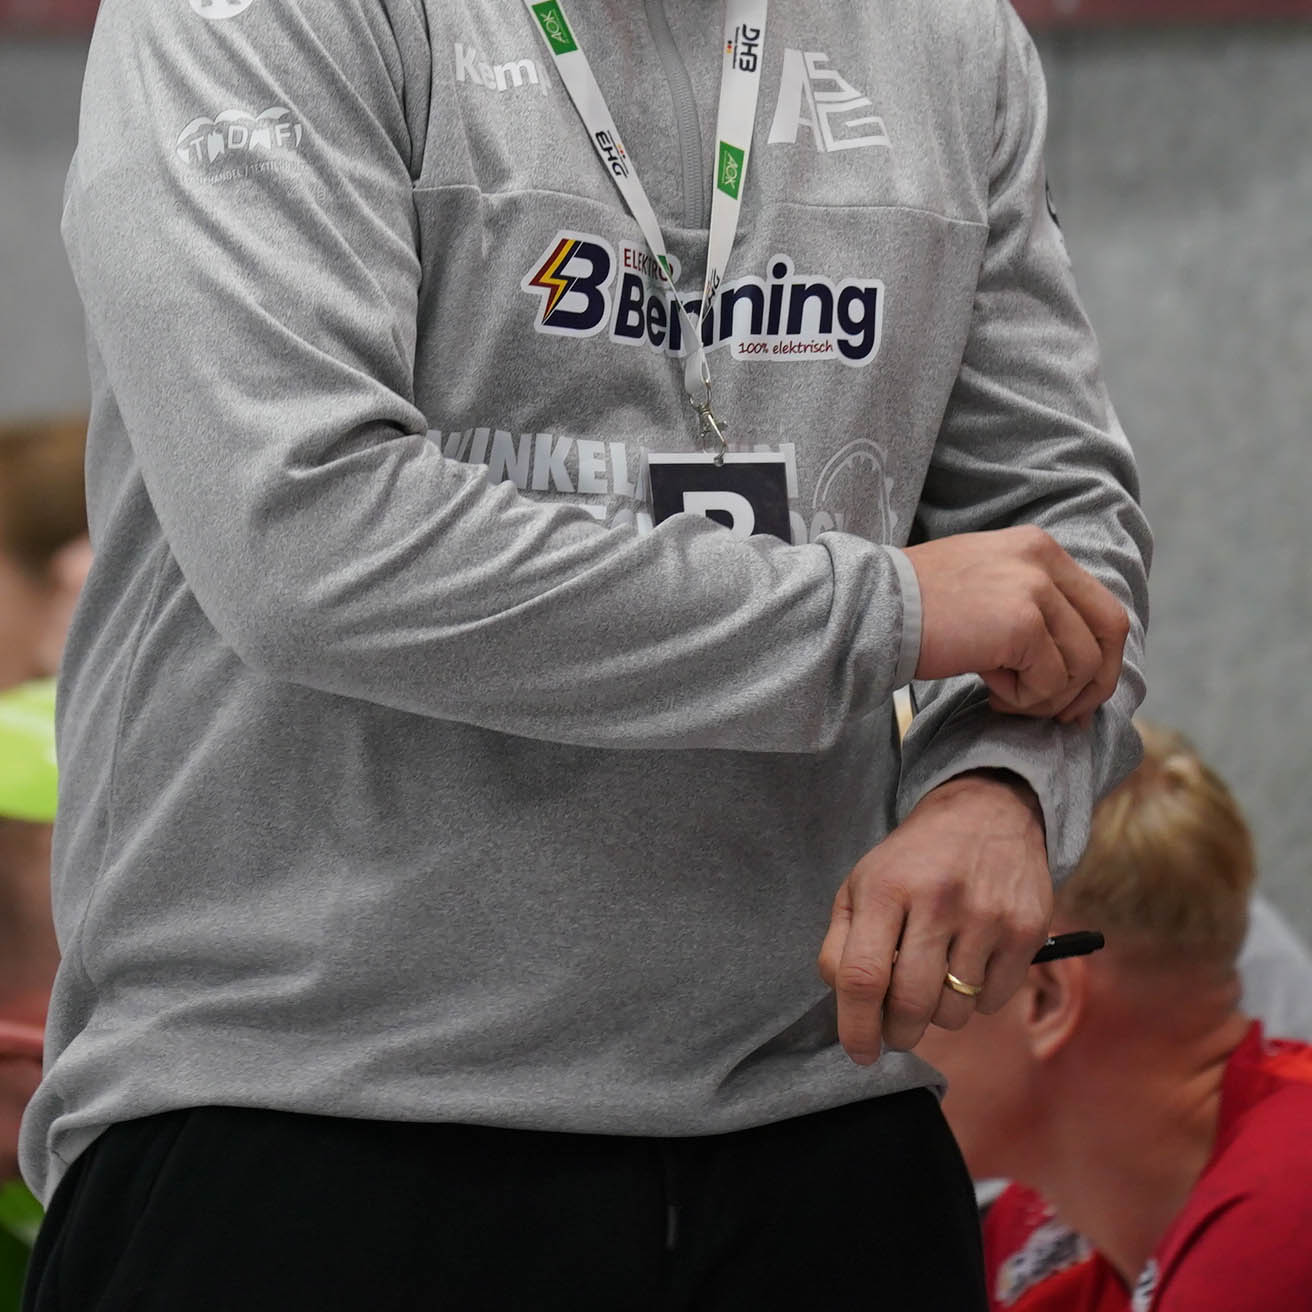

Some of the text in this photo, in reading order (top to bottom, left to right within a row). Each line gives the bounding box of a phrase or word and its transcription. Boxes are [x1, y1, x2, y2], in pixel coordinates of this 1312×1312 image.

[540, 9, 566, 44] AOK
[722, 154, 738, 191] AOK
[613, 261, 878, 361] Benning
[738, 339, 834, 355] 100% elektrisch
